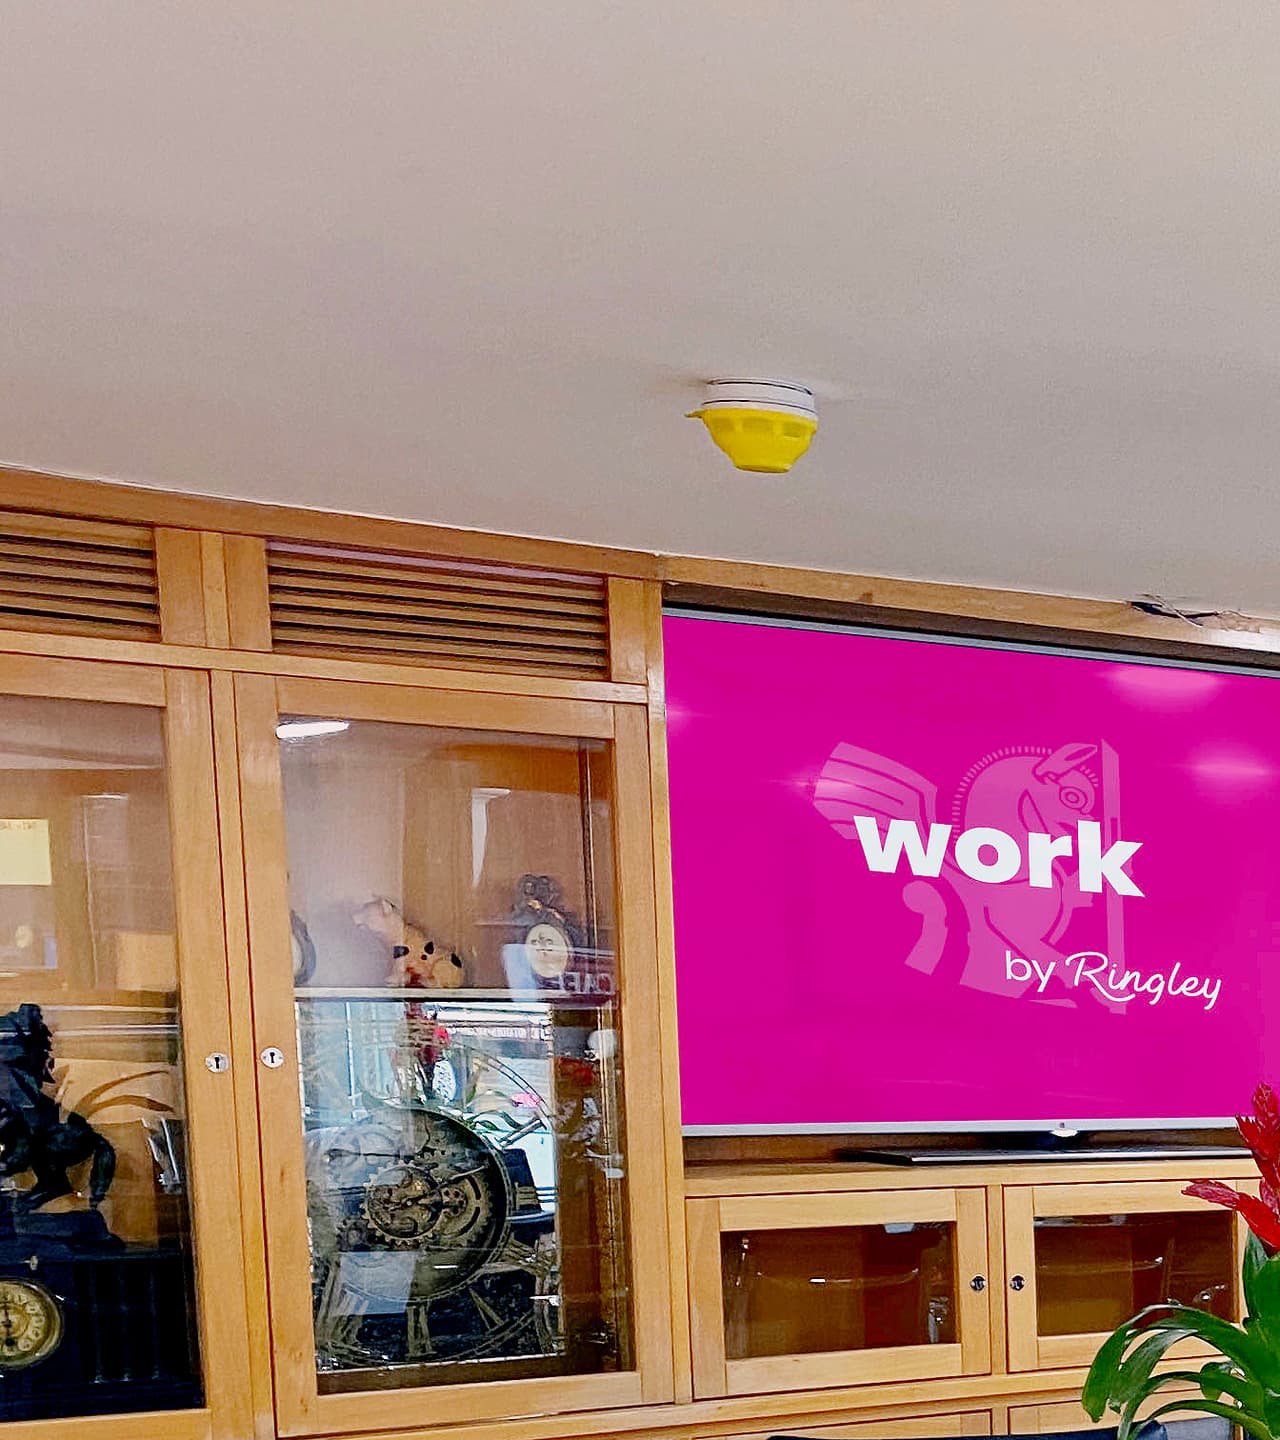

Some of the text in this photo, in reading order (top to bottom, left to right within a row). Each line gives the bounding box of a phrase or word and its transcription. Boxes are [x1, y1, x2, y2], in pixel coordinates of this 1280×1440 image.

[853, 815, 1145, 897] work
[1005, 951, 1222, 1010] by Ringley
